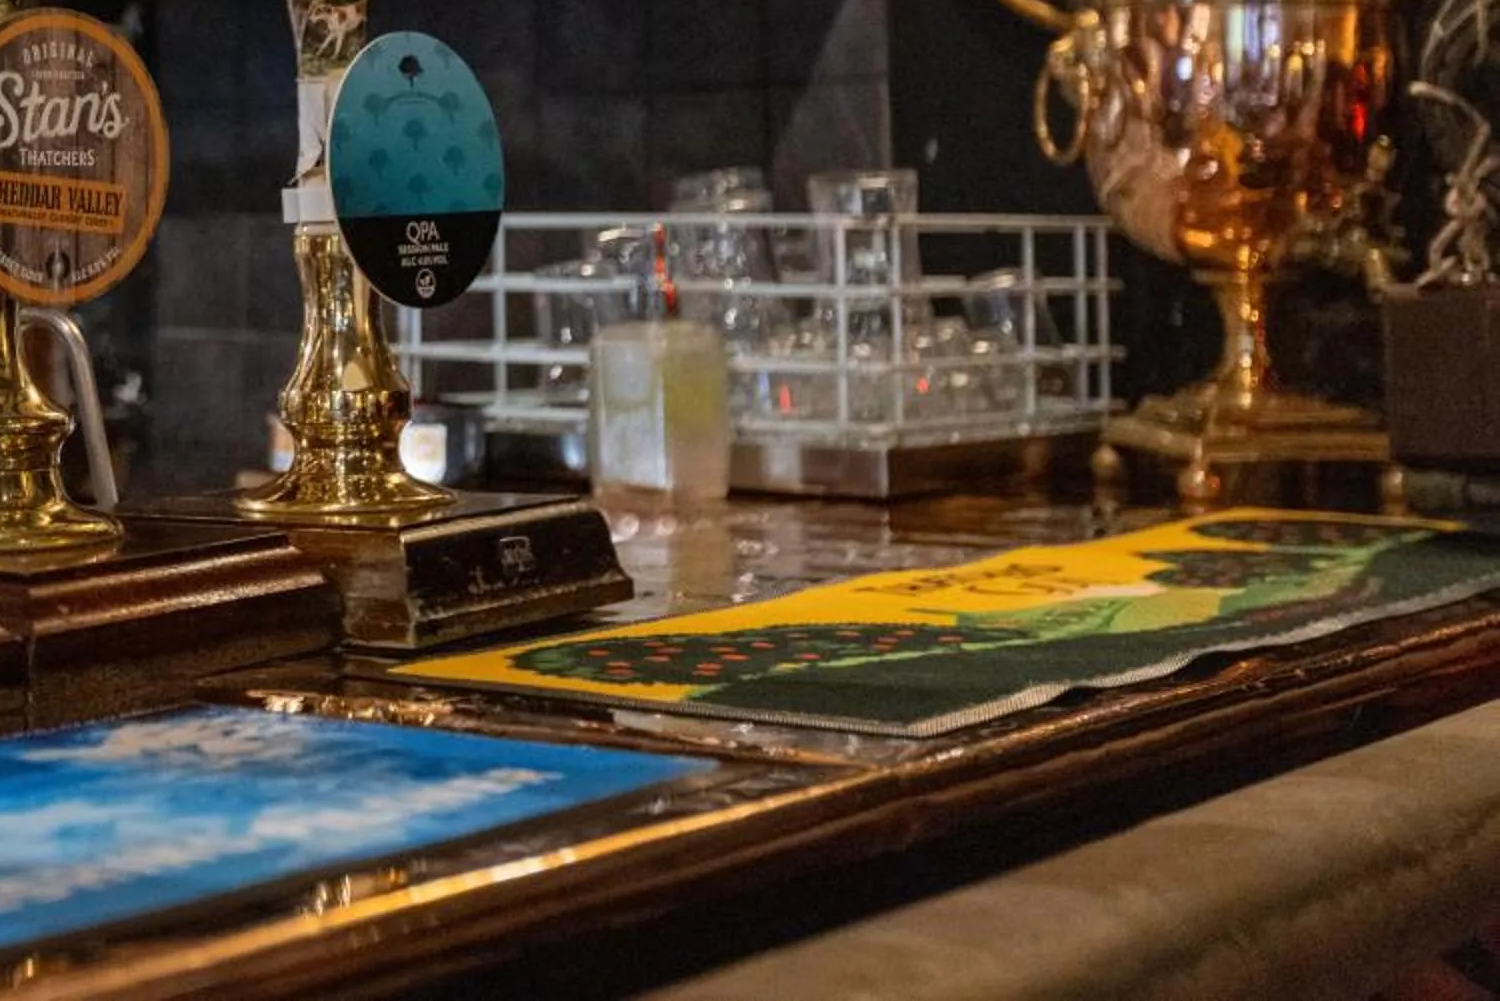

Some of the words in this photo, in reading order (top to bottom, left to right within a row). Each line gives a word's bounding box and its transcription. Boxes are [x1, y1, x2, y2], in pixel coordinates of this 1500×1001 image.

[19, 147, 97, 167] THATCHERS
[68, 186, 123, 216] VALLEY
[406, 221, 440, 245] QPA
